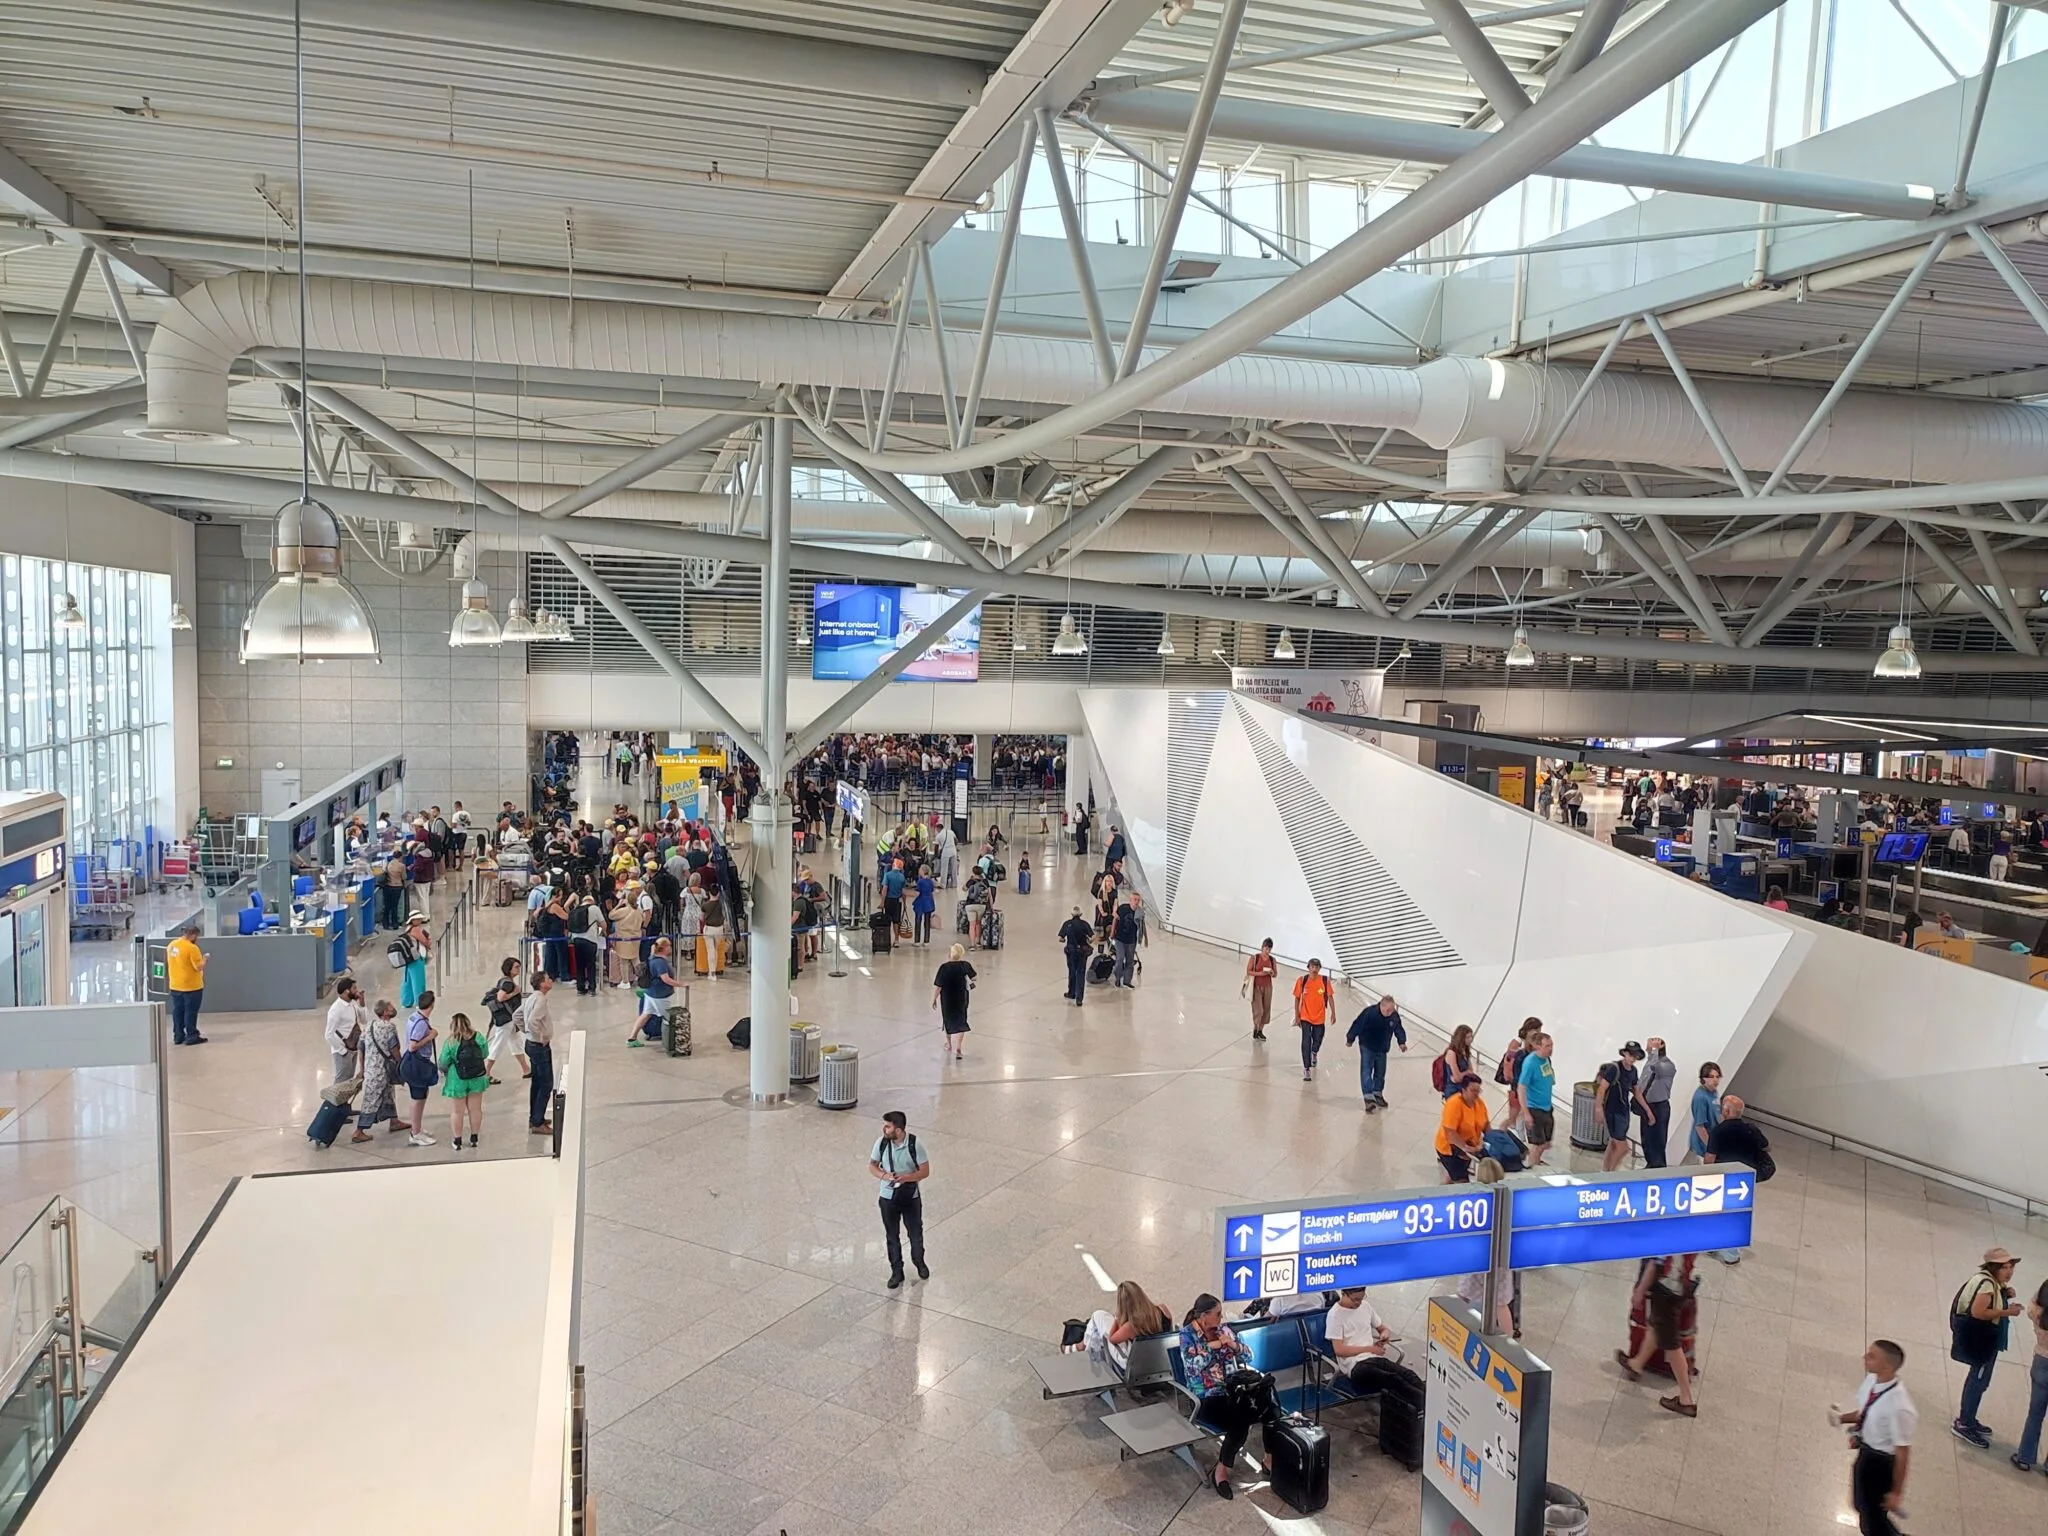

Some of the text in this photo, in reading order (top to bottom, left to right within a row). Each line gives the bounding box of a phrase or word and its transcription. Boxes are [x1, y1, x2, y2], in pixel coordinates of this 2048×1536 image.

[819, 620, 880, 630] Internet onboard,
[818, 628, 832, 637] just
[832, 628, 845, 636] like
[1985, 804, 1994, 814] 10
[1942, 811, 1951, 821] 11
[1896, 822, 1906, 832] 12
[1850, 832, 1859, 842] 13
[1659, 844, 1671, 856] 15
[1778, 842, 1790, 854] 14
[56, 846, 63, 870] 3
[1576, 1189, 1610, 1205] Έξοδοι
[1614, 1182, 1690, 1218] A, B, C
[1301, 1208, 1399, 1229] Έλεγχος Εισιτηρίων
[1403, 1198, 1489, 1235] 93-160
[1578, 1207, 1603, 1219] Gates
[1303, 1230, 1343, 1245] Check-in
[1305, 1253, 1358, 1271] Τουαλέτες
[1269, 1268, 1290, 1283] WC
[1304, 1272, 1335, 1286] Toilets
